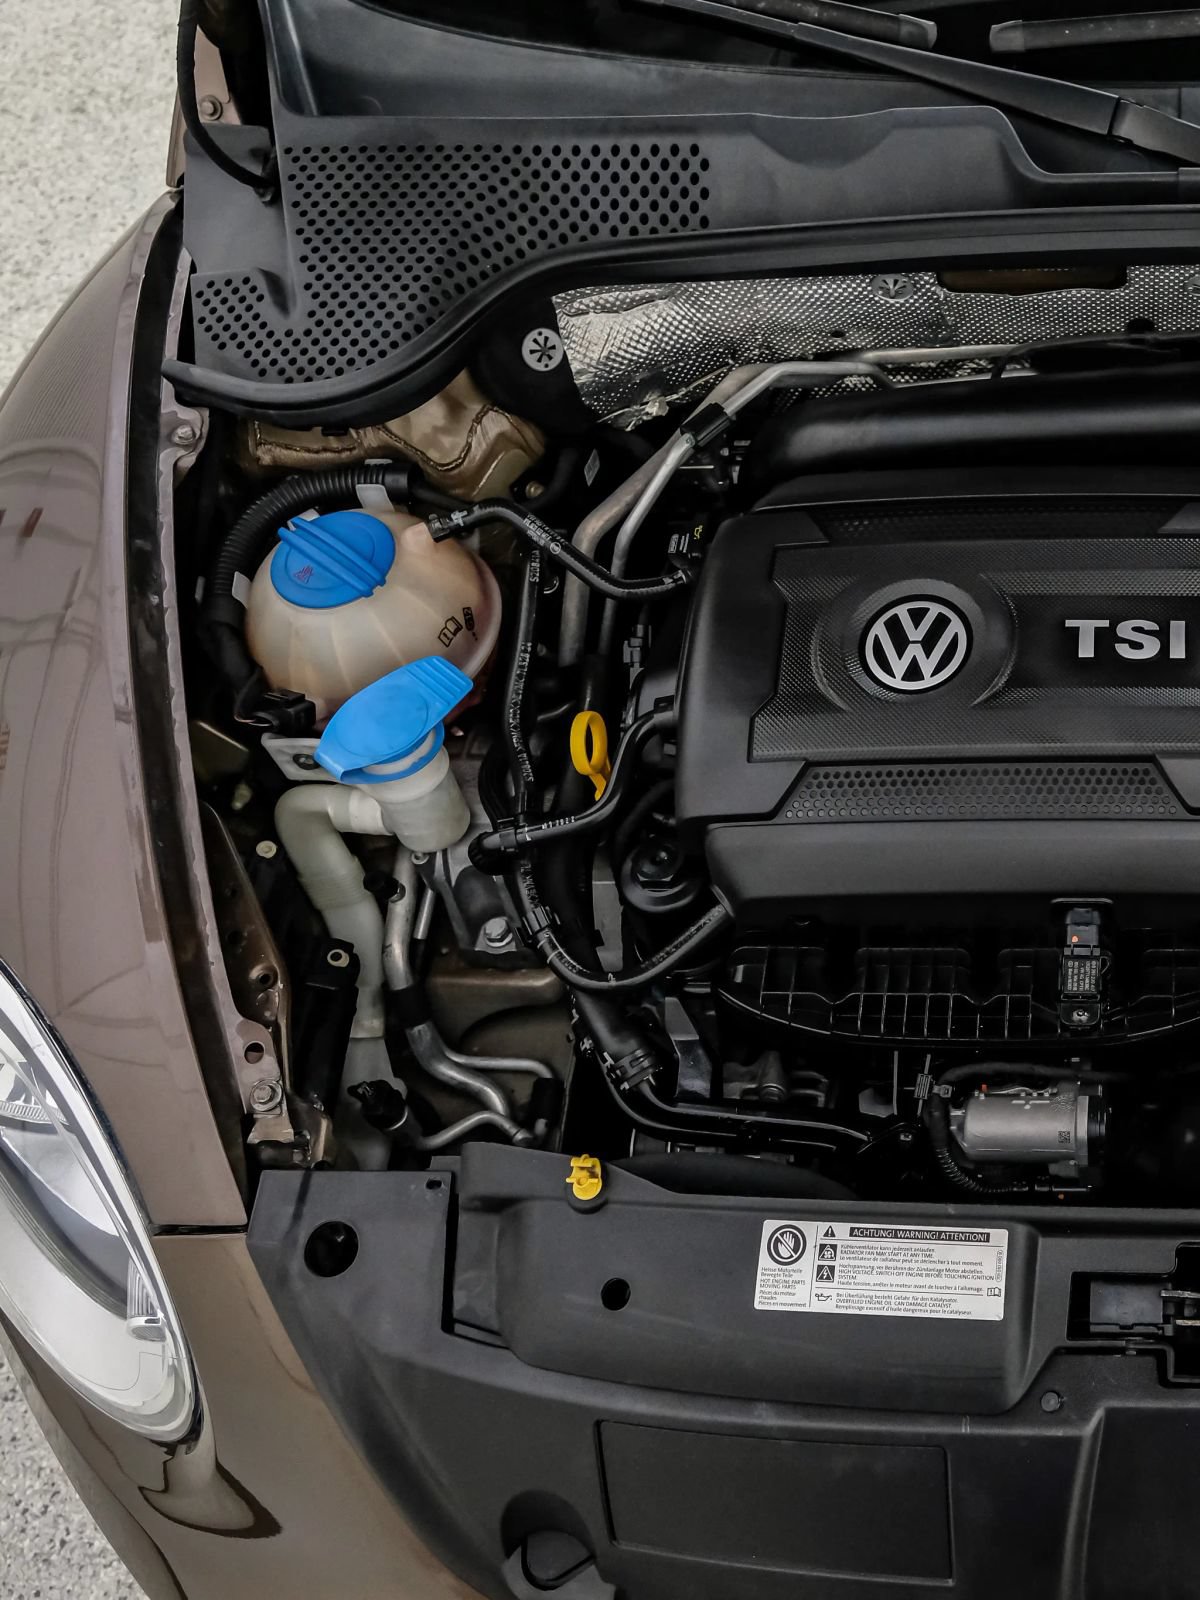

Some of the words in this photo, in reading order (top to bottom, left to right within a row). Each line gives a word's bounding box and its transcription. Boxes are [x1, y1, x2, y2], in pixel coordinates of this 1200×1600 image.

[1065, 619, 1186, 659] TSI
[853, 1228, 895, 1238] ACHTUNG!
[897, 1230, 939, 1240] WARNING!
[940, 1232, 987, 1242] ATTENTION!
